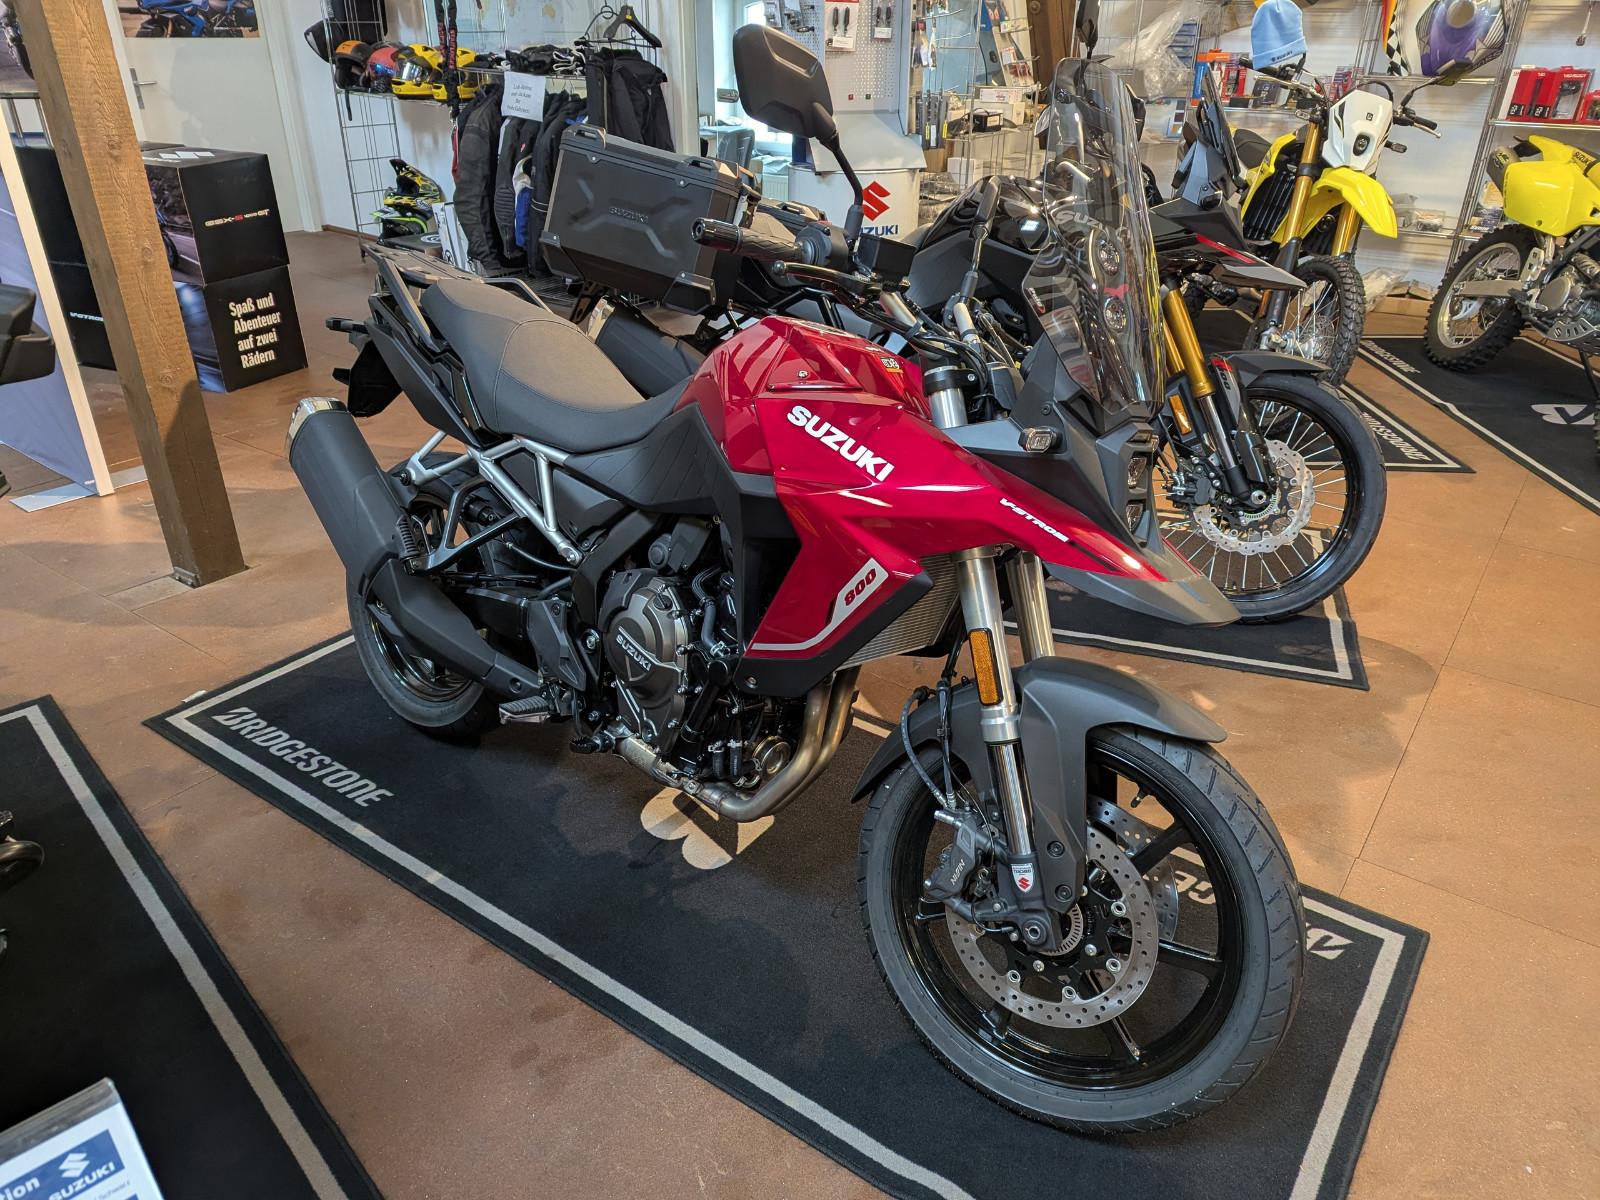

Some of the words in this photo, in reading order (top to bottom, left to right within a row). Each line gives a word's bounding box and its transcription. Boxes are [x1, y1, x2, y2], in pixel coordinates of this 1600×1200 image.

[860, 224, 899, 237] ZUKI
[69, 311, 104, 322] V-STRO
[228, 297, 255, 318] Spaß
[256, 292, 275, 310] und
[234, 311, 281, 335] Abenteuer
[238, 334, 254, 352] auf
[256, 327, 278, 347] zwei
[240, 349, 276, 369] Rädern
[787, 405, 895, 482] SUZUKI
[999, 497, 1070, 543] V-STROM
[844, 568, 877, 606] 800
[616, 634, 652, 671] SUZUKI
[211, 706, 395, 807] BRIDGESTONE
[48, 1161, 116, 1200] SUZUKI
